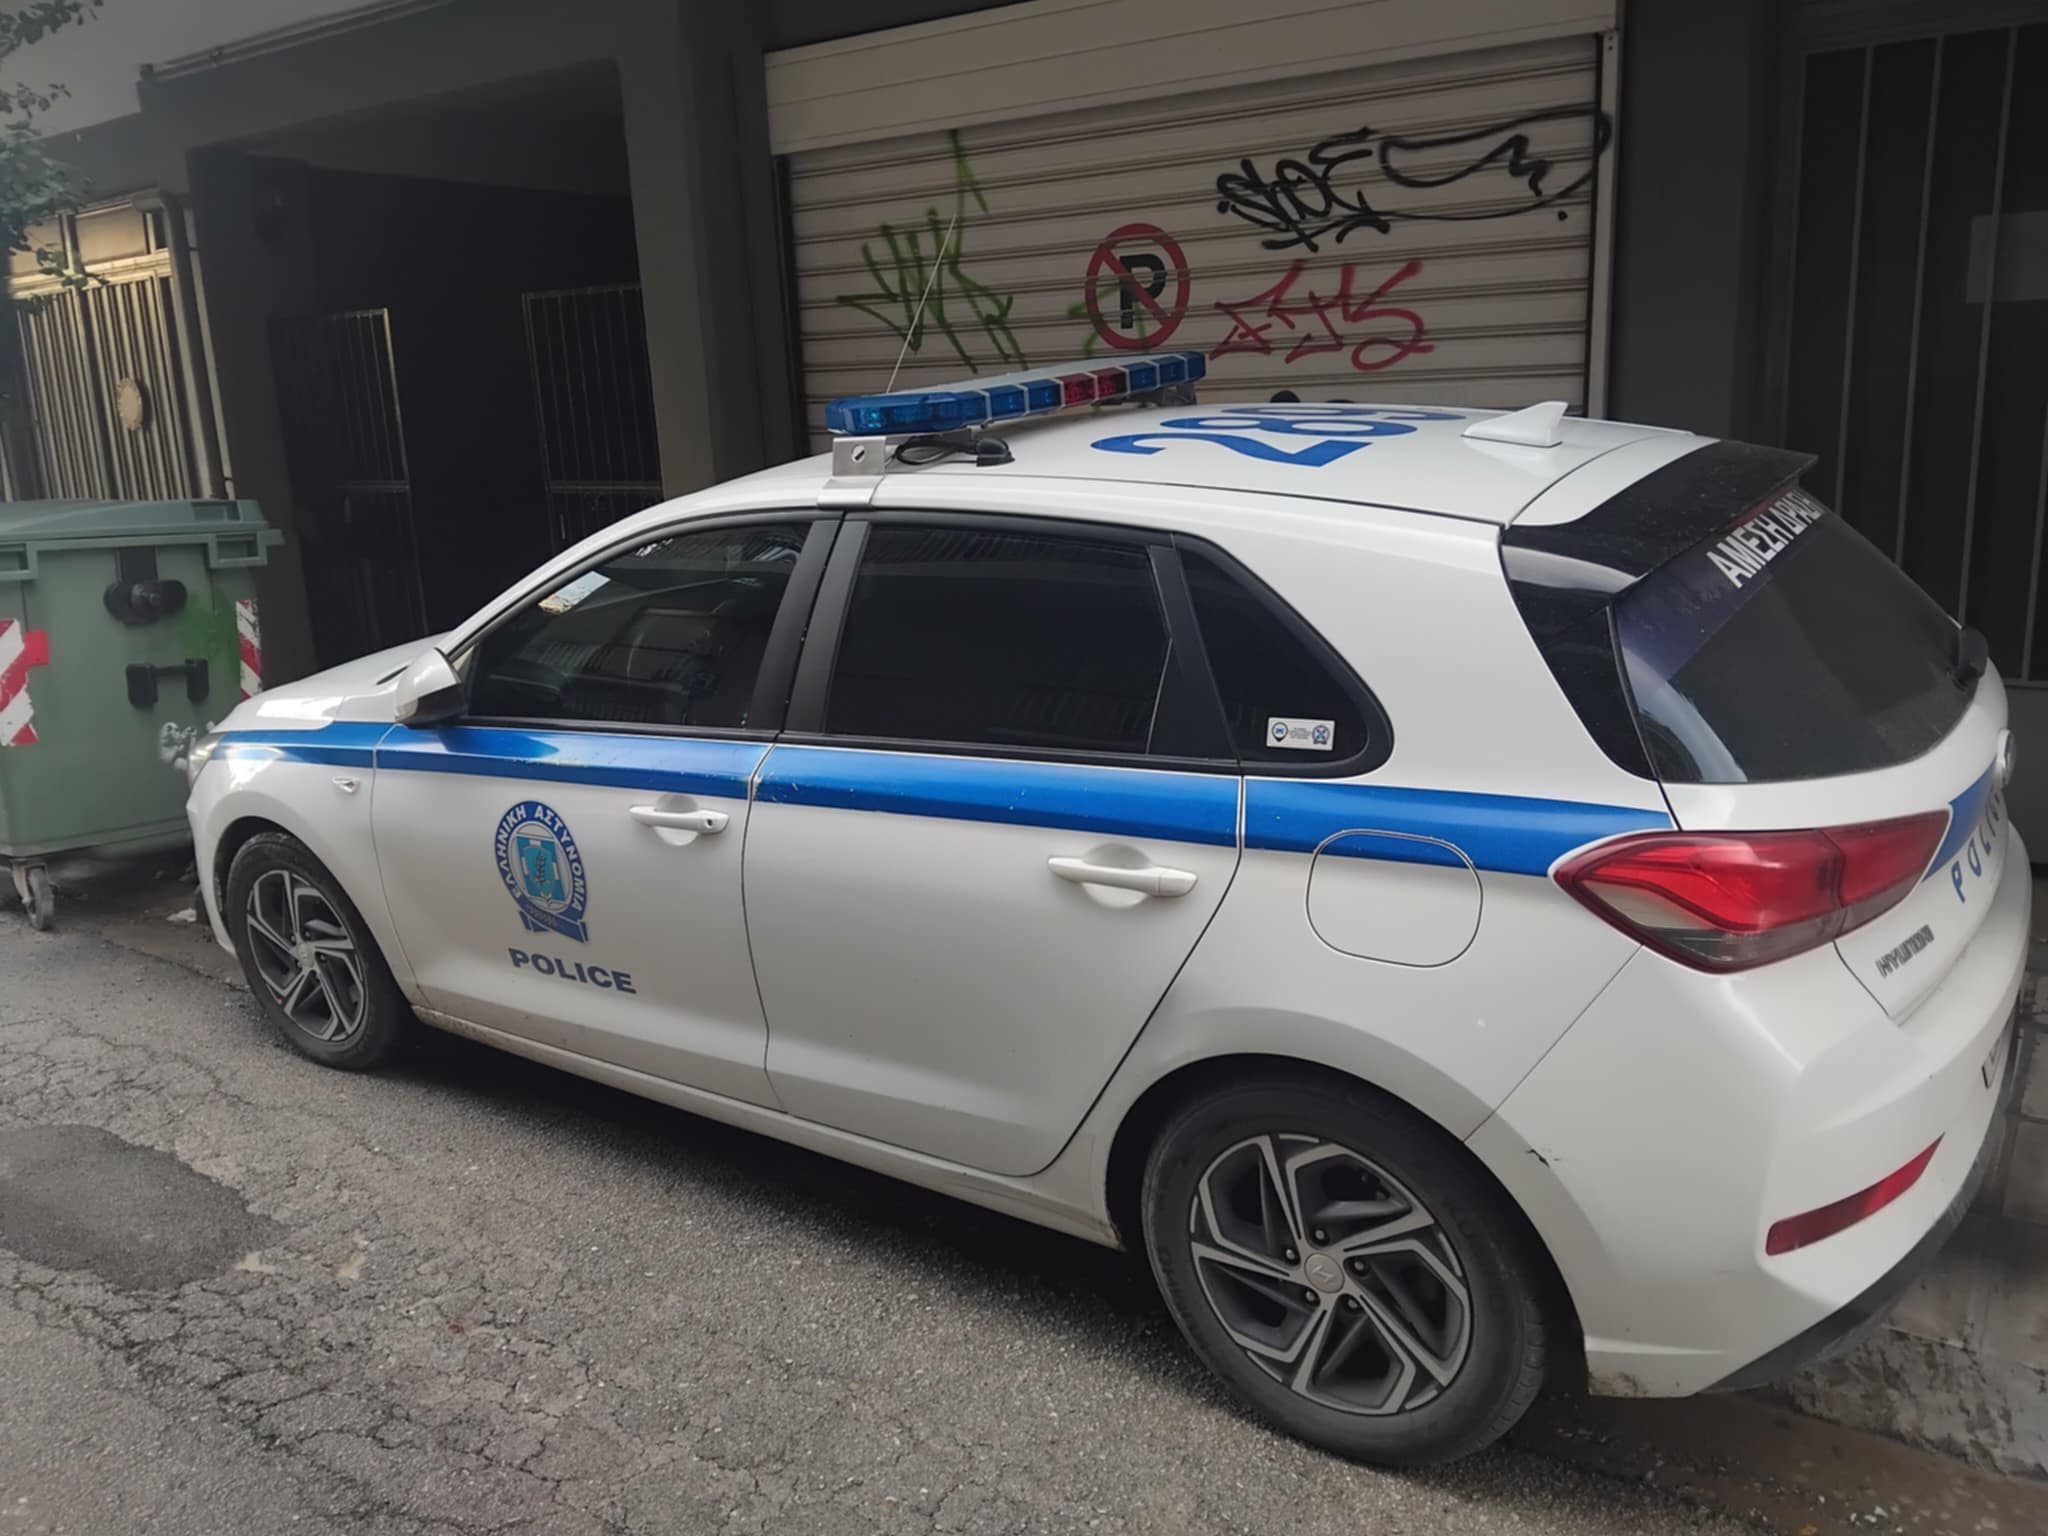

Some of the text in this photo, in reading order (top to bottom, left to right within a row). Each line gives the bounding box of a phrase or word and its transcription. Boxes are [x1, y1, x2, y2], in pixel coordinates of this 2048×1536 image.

[1119, 254, 1167, 330] P
[1706, 514, 1795, 589] ΑΜΕΣΗ
[534, 804, 585, 911] ΑΣΤΥΝΟΜΙΑ
[508, 947, 637, 995] POLICE
